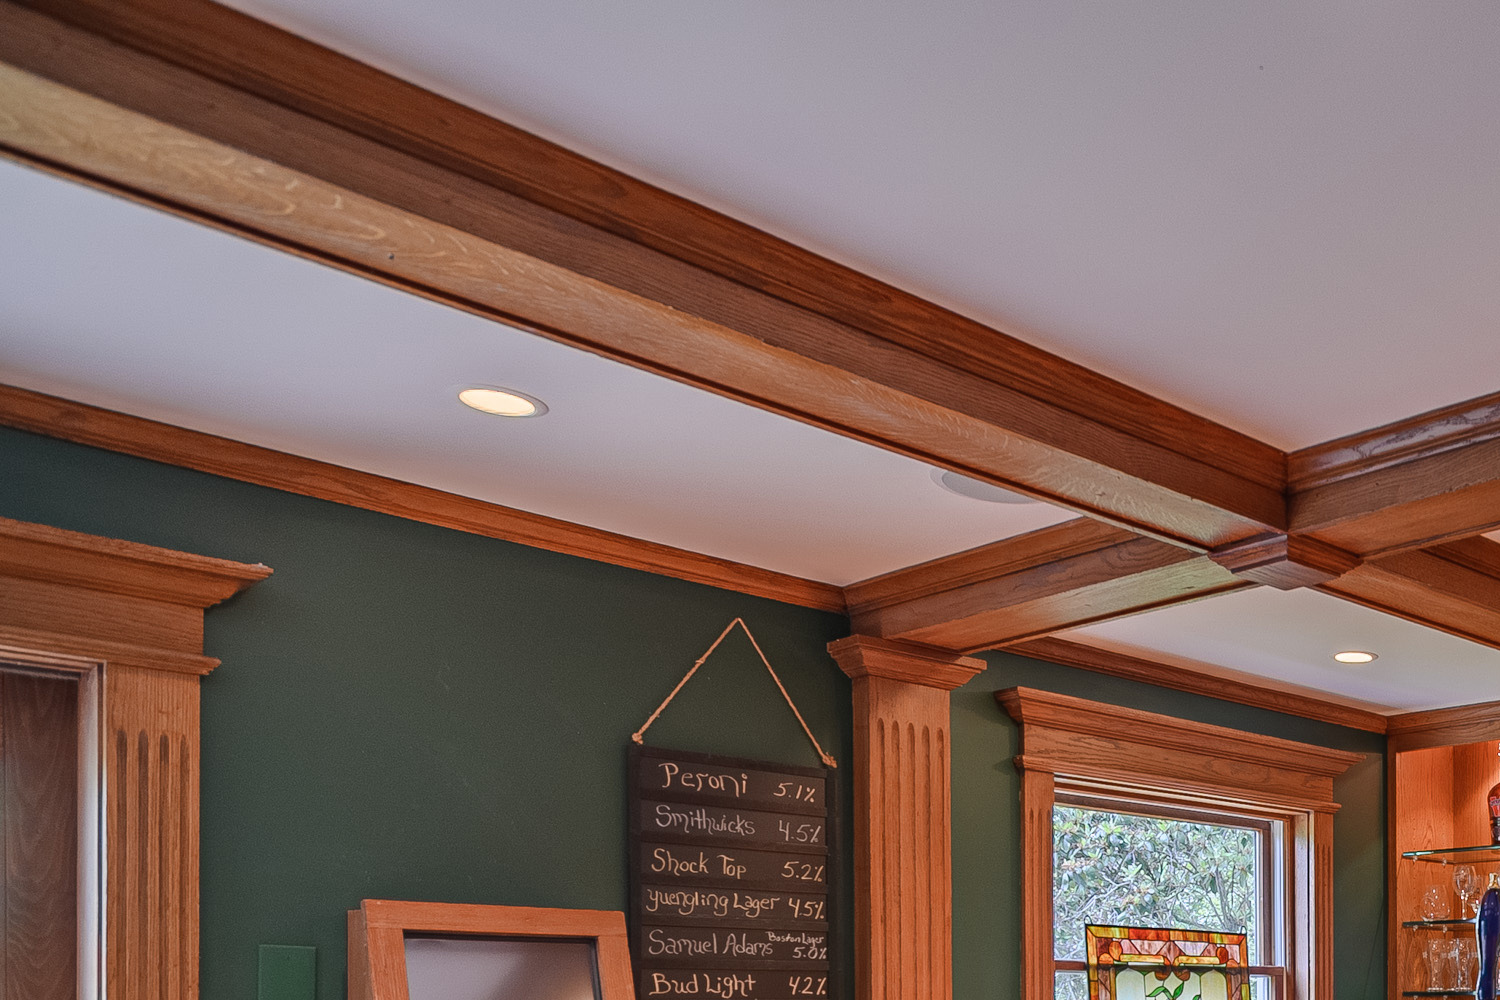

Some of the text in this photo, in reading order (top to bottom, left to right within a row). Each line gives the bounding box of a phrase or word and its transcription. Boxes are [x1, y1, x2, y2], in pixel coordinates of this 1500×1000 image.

[658, 762, 816, 803] Peroni 5.1%
[655, 804, 822, 843] Smithwicks 4.5%
[651, 847, 825, 883] Shock Top 5.2%
[733, 892, 781, 918] Lager
[648, 928, 774, 957] Samuel Adams
[765, 930, 825, 948] Boston Lager
[648, 972, 757, 999] Bud Light
